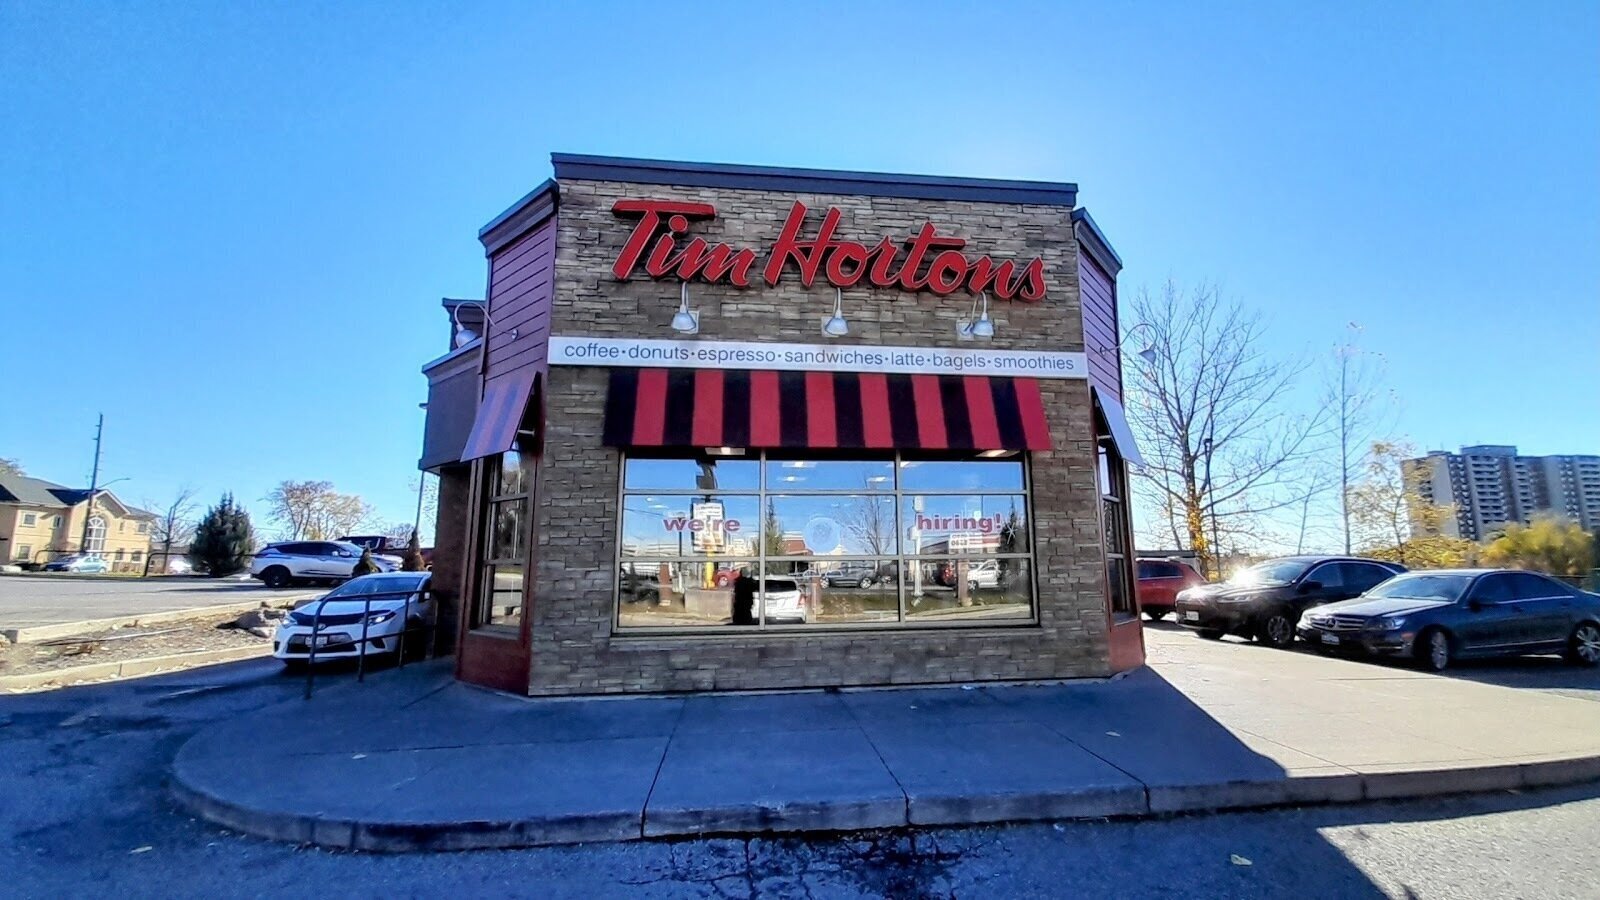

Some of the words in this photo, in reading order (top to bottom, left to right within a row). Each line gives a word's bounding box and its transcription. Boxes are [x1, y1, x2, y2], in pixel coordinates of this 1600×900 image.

[611, 199, 756, 287] Tim
[762, 199, 1047, 302] Hortons
[564, 342, 619, 359] coffee
[628, 344, 689, 361] donuts
[697, 349, 776, 365] espresso
[784, 348, 883, 366] sandwiches
[891, 351, 925, 367] latte
[932, 352, 987, 371] bagels
[994, 354, 1075, 370] smoothies
[917, 513, 1001, 532] hiring!
